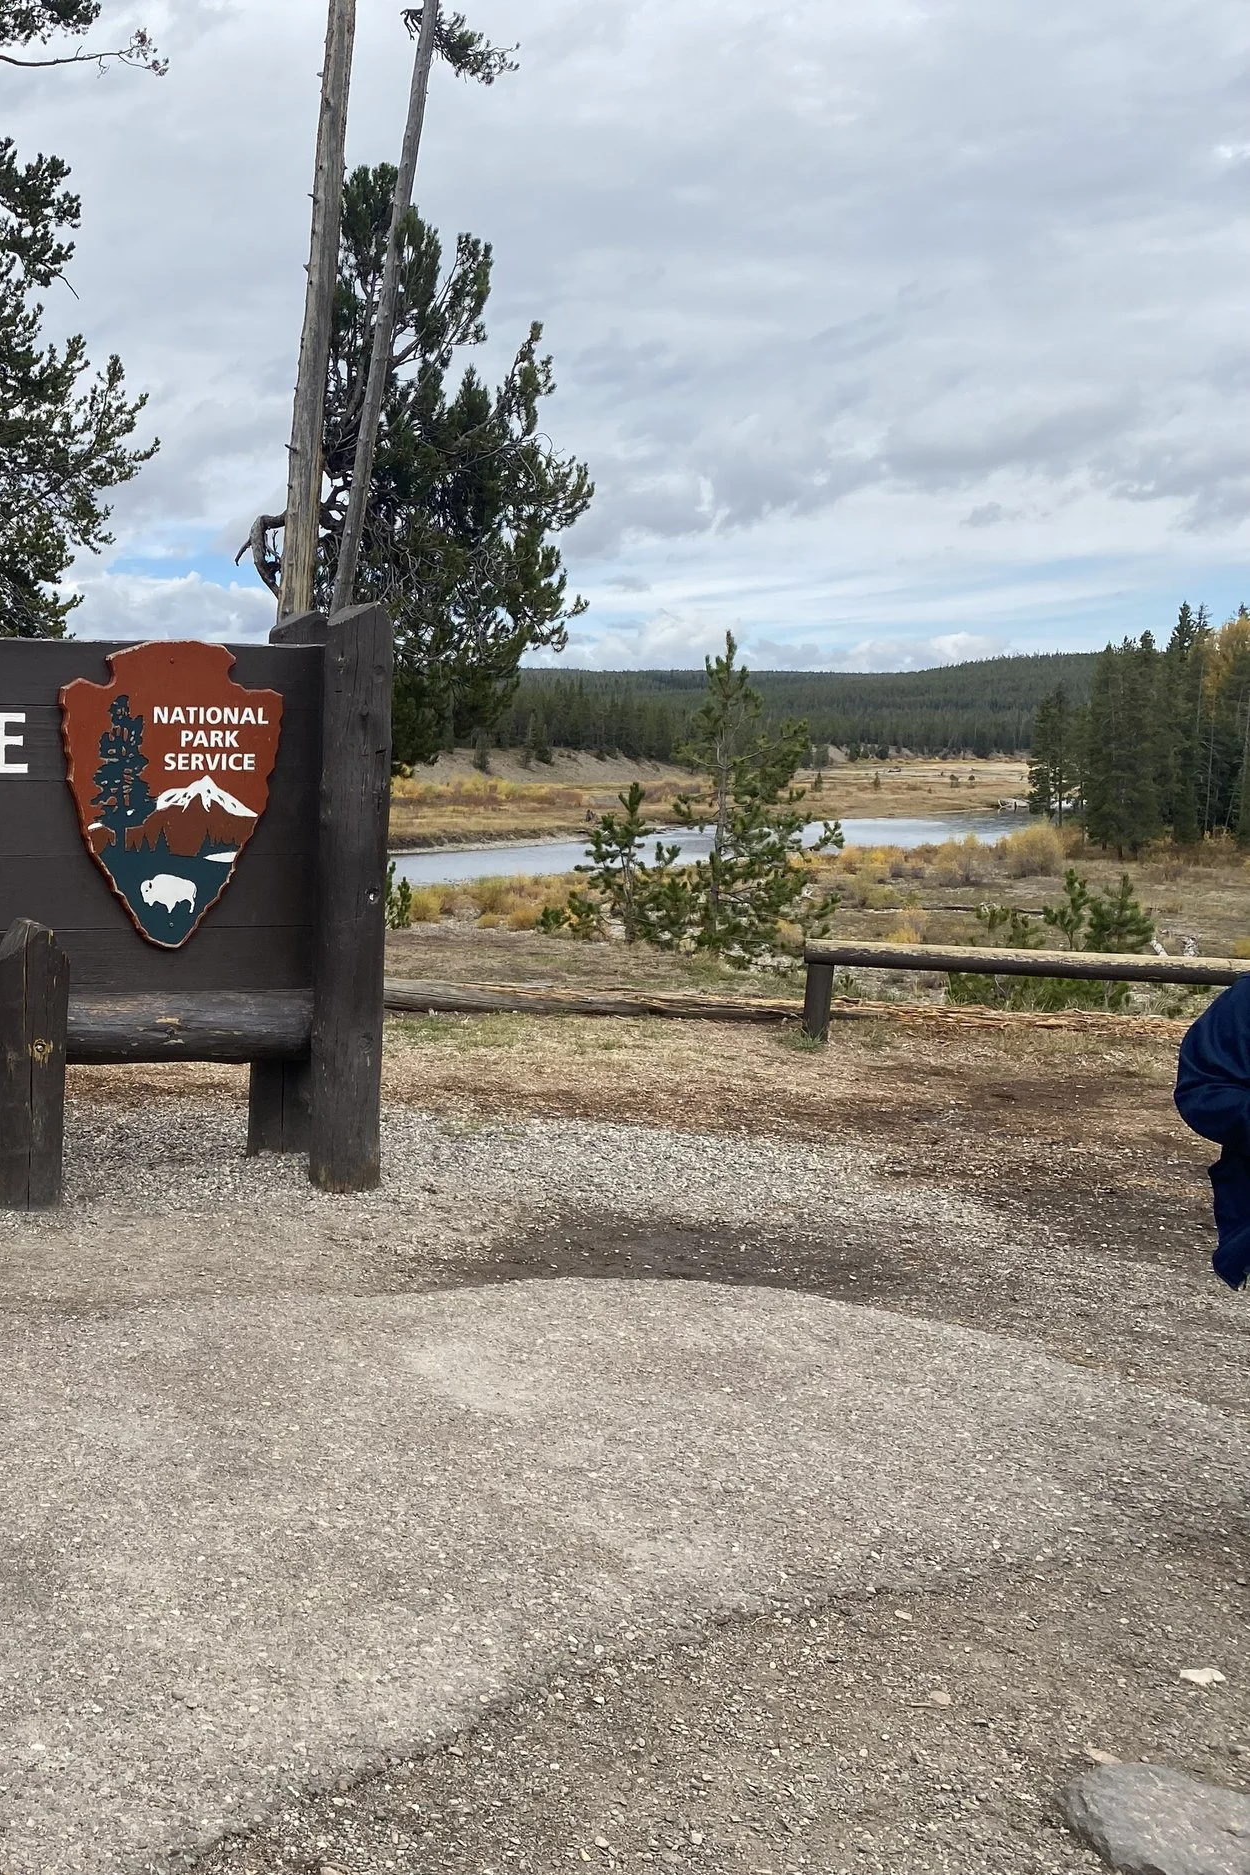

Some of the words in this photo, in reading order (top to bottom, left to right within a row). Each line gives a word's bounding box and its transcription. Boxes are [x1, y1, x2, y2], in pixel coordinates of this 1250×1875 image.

[152, 706, 270, 726] NATIONAL
[180, 729, 240, 748] PARK
[163, 752, 257, 772] SERVICE
